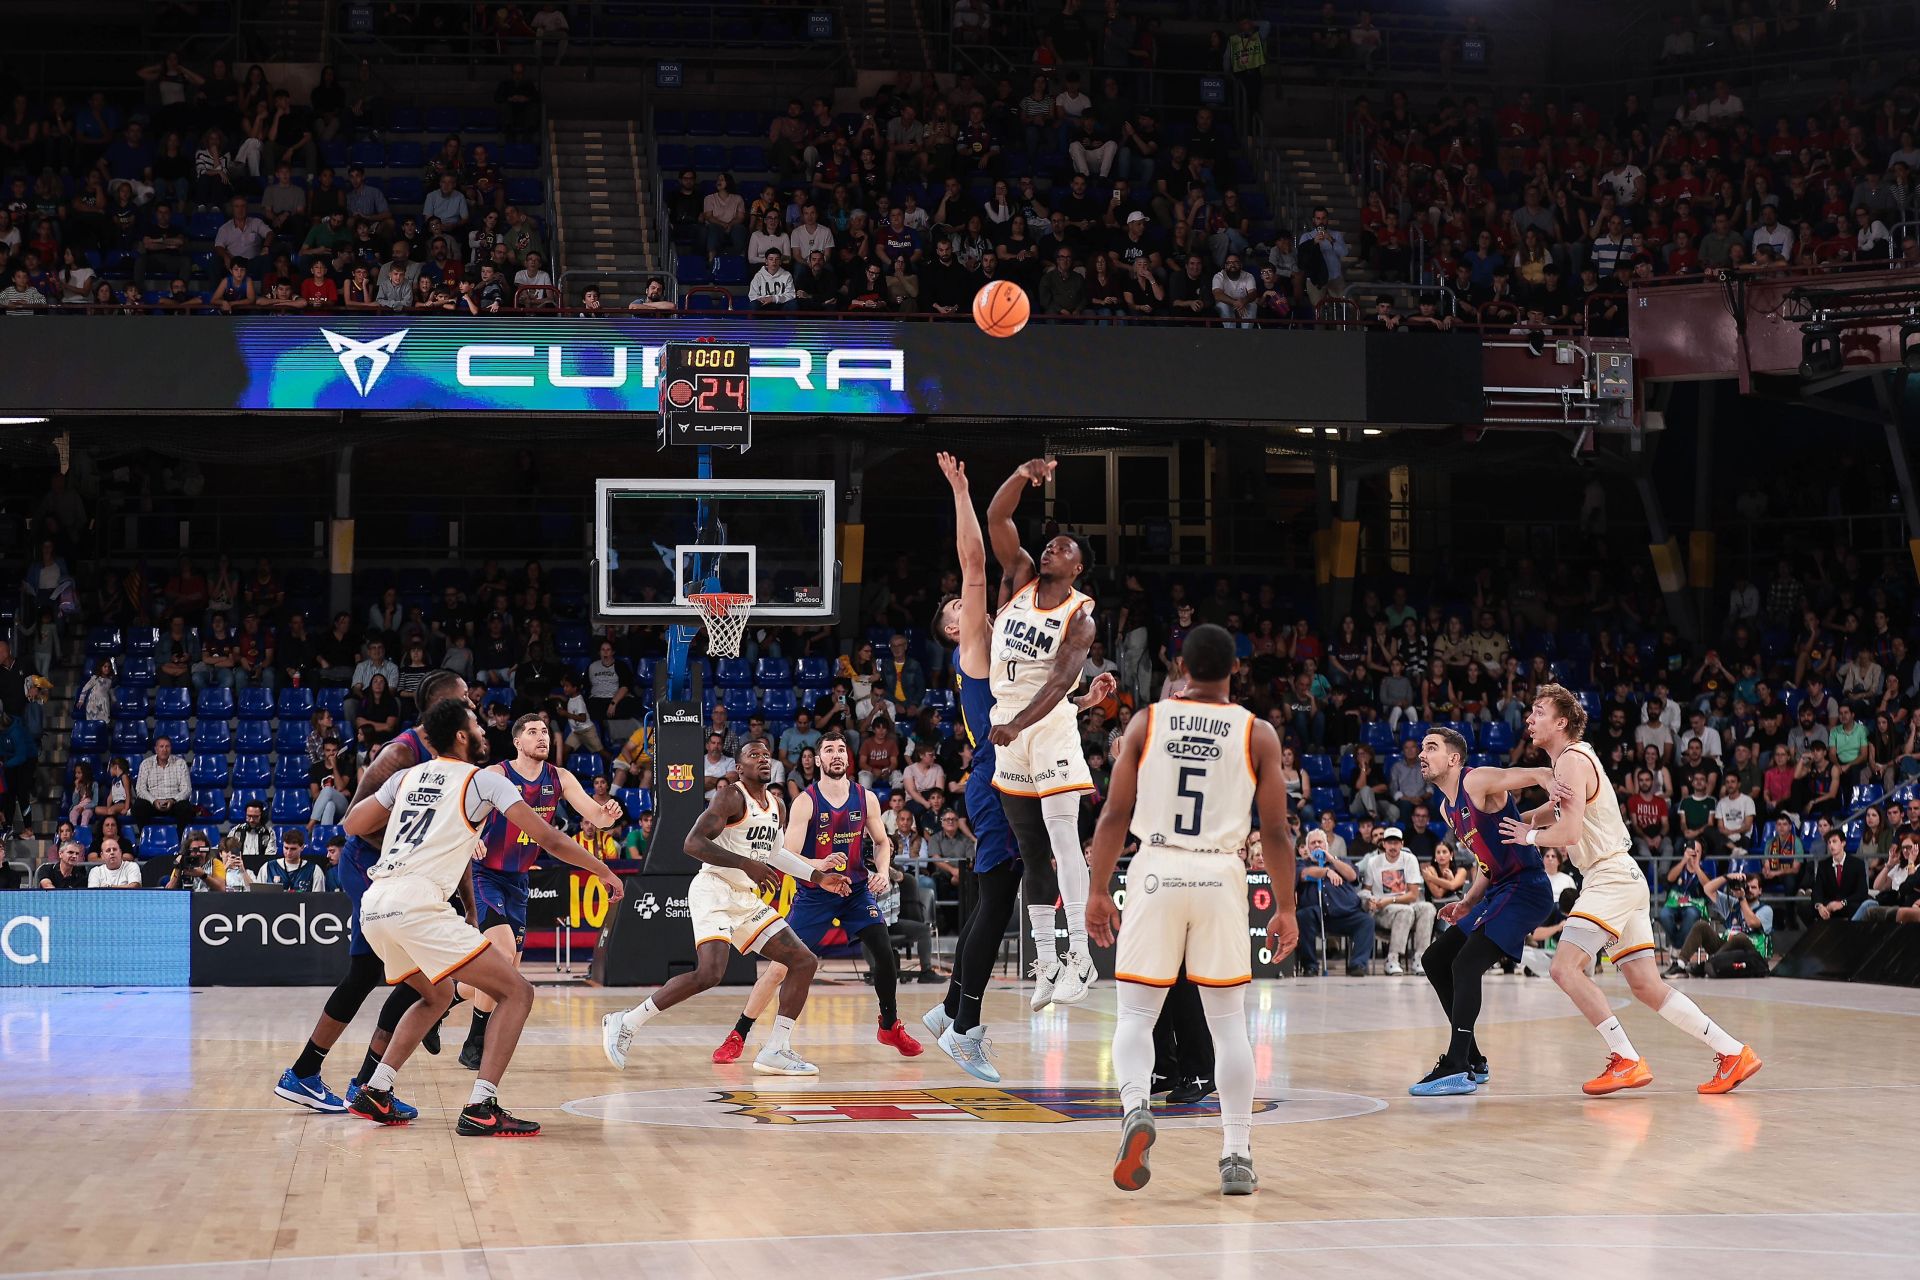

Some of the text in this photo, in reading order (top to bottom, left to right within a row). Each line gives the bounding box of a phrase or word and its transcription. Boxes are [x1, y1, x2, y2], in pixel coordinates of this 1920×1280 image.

[455, 345, 905, 392] CURA
[687, 349, 735, 368] 10:00
[698, 377, 745, 411] 24
[1003, 618, 1054, 654] UCAM
[1005, 637, 1038, 660] MURCIA
[663, 714, 700, 724] SPALDING
[1170, 715, 1231, 738] DEJULIUS
[1174, 766, 1207, 836] 5
[527, 887, 558, 899] ilson
[665, 896, 689, 907] Assi
[1254, 888, 1271, 910] 0
[665, 906, 690, 918] Sanit
[199, 903, 351, 946] ende
[1258, 947, 1272, 964] 0
